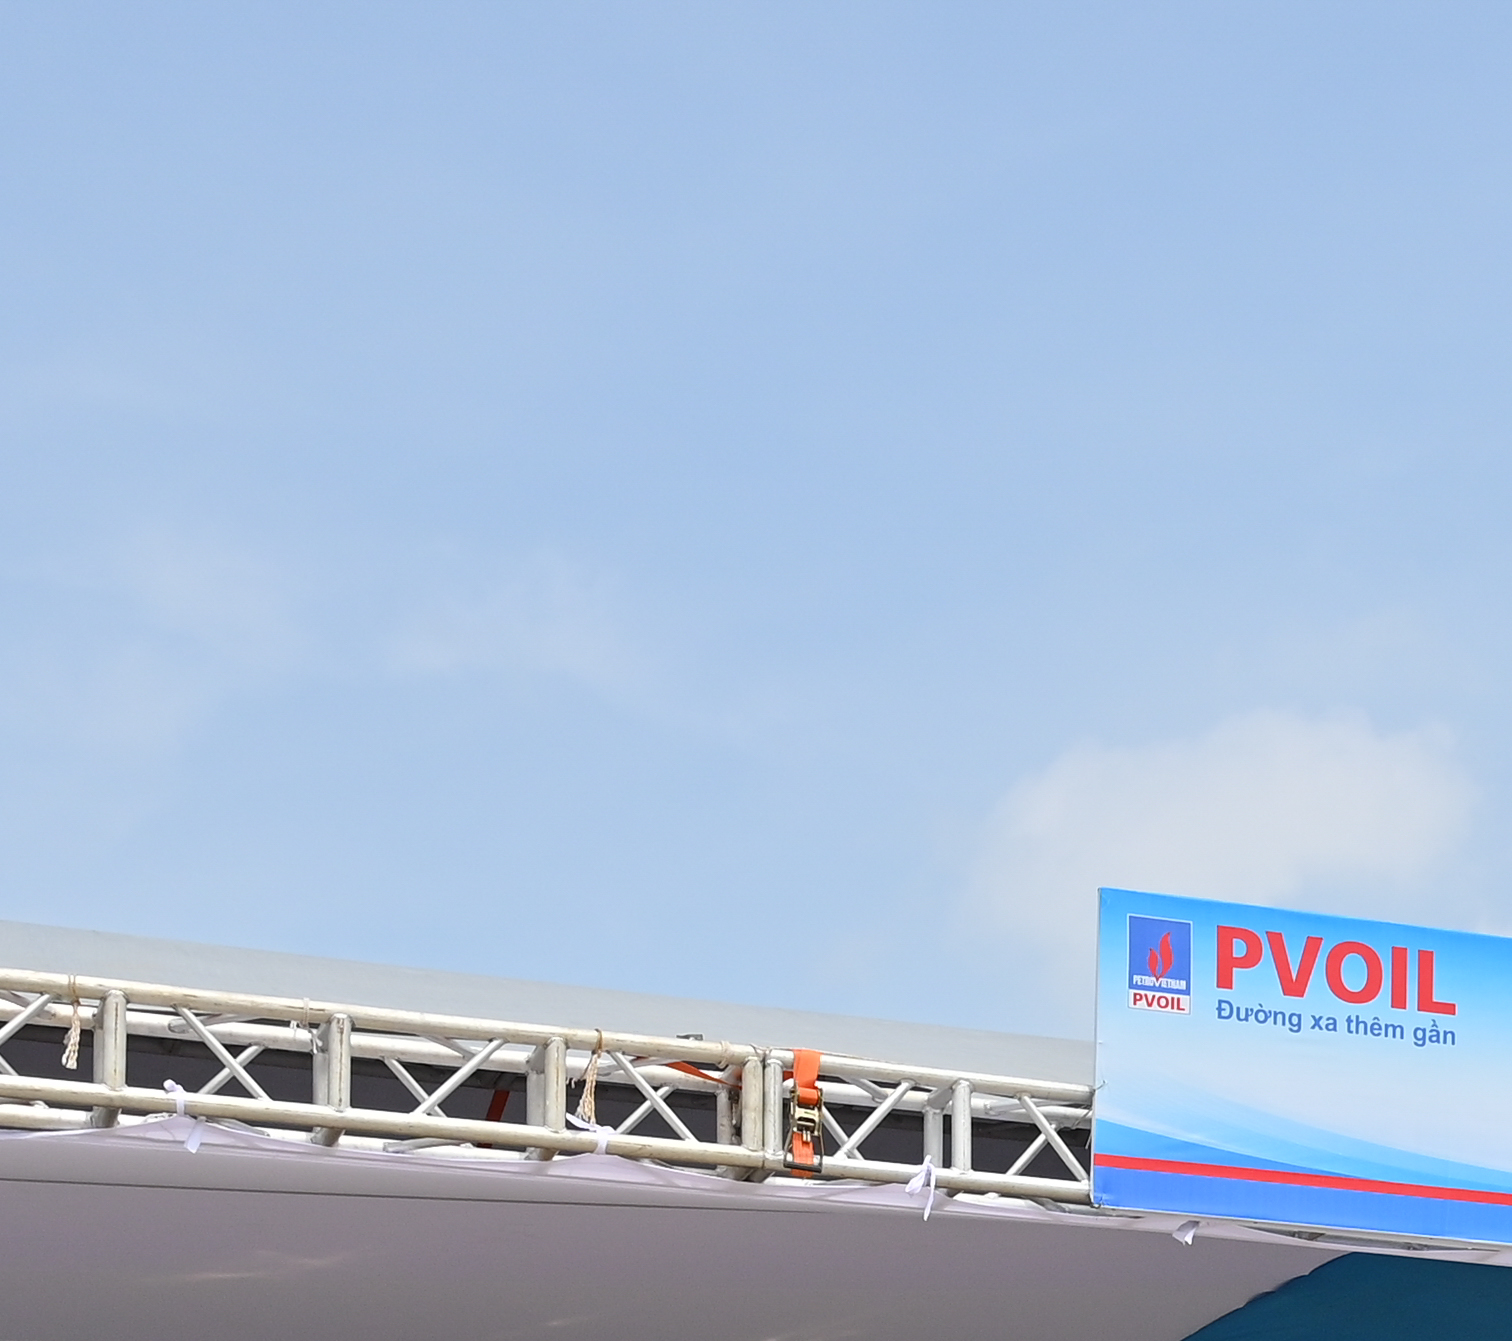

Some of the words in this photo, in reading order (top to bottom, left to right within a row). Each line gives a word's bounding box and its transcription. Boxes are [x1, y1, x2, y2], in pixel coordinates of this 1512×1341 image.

[1216, 925, 1457, 1016] PVOIL
[1133, 992, 1186, 1011] PVOIL
[1216, 999, 1302, 1033] Đường
[1310, 1013, 1338, 1033] xa
[1346, 1013, 1405, 1041] thêm
[1413, 1018, 1456, 1048] gần
